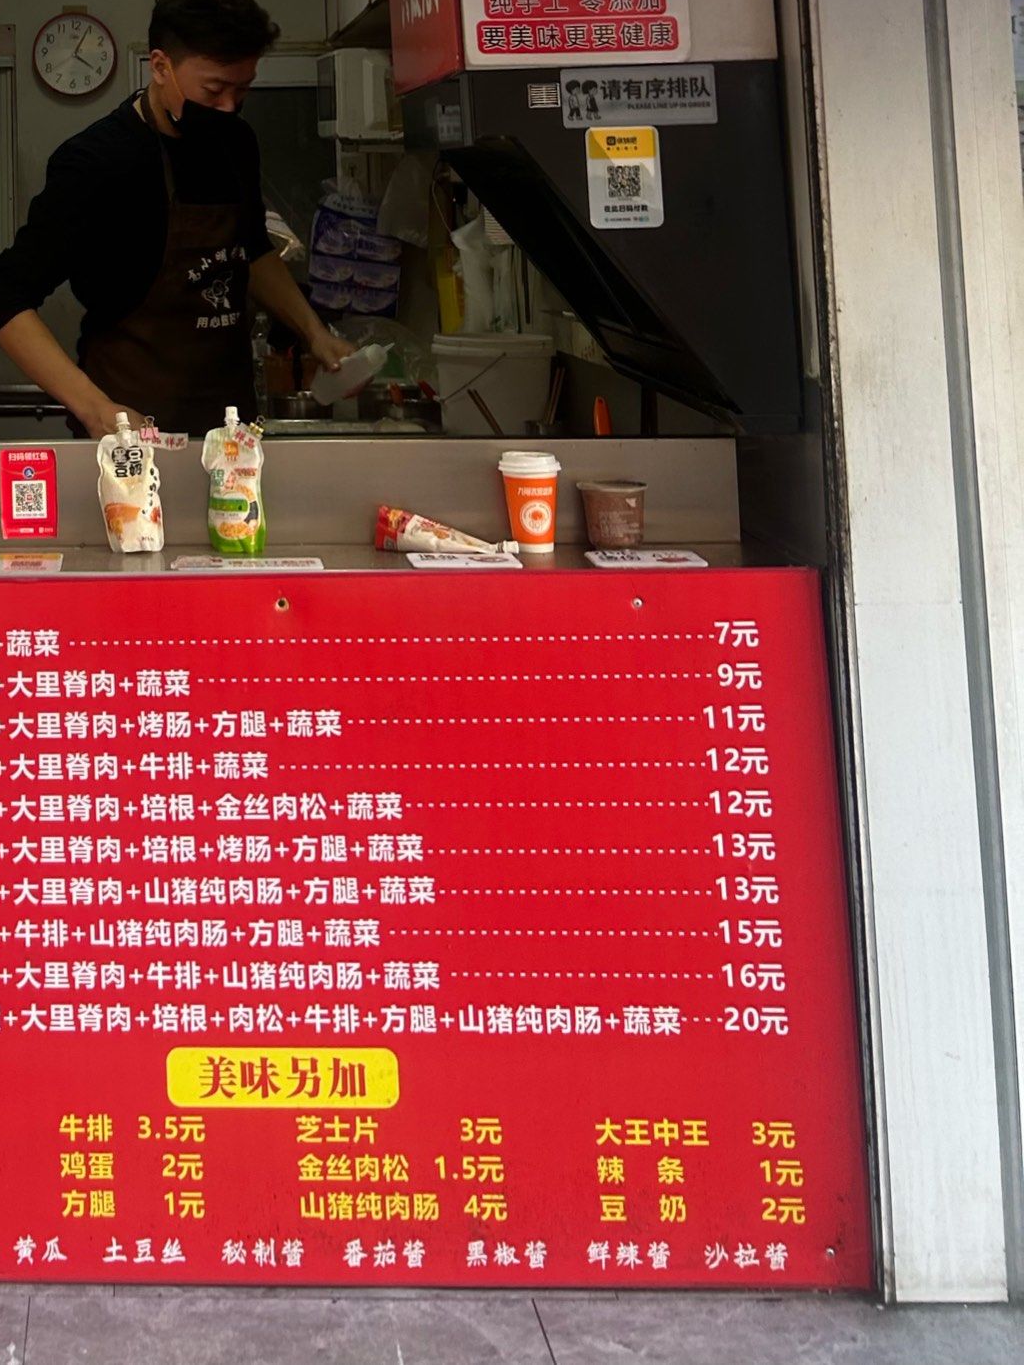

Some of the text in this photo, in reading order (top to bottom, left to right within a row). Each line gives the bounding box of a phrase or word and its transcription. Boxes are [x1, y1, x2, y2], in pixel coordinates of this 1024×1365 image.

[482, 23, 673, 50] 要美味更要健康
[600, 77, 711, 100] 请有序排队
[714, 621, 759, 647] 7元
[718, 663, 762, 689] 9元
[703, 705, 765, 731] 11元
[706, 748, 768, 774] 12元
[710, 791, 772, 817] 12元
[713, 834, 775, 860] 13元
[716, 877, 779, 904] 13元
[719, 920, 782, 947] 15元
[722, 963, 785, 991] 16元
[725, 1007, 788, 1035] 20元
[197, 1055, 367, 1100] 美味另加
[59, 1114, 113, 1142] 牛排
[138, 1116, 205, 1142] 3.5元
[296, 1115, 378, 1144] 芝士片
[461, 1118, 502, 1144] 3元
[595, 1118, 709, 1146] 大王中王
[752, 1122, 795, 1148] 3元
[60, 1152, 114, 1179] 鸡蛋
[162, 1154, 203, 1180] 2元
[298, 1153, 409, 1182] 金丝肉松
[435, 1156, 504, 1183] 1.5元
[760, 1160, 803, 1187] 1元
[62, 1190, 115, 1217] 方腿
[164, 1192, 205, 1218] 1元
[301, 1192, 439, 1220] 山猪纯肉肠
[464, 1194, 507, 1221] 4元
[762, 1198, 805, 1224] 2元
[13, 1237, 68, 1263] 黄瓜
[103, 1238, 186, 1264] 土豆丝
[222, 1238, 305, 1268] 秘制酱
[343, 1238, 426, 1269] 番茄酱
[466, 1240, 548, 1270] 黑椒酱
[587, 1240, 671, 1270] 鲜辣酱
[704, 1243, 789, 1270] 沙拉酱
